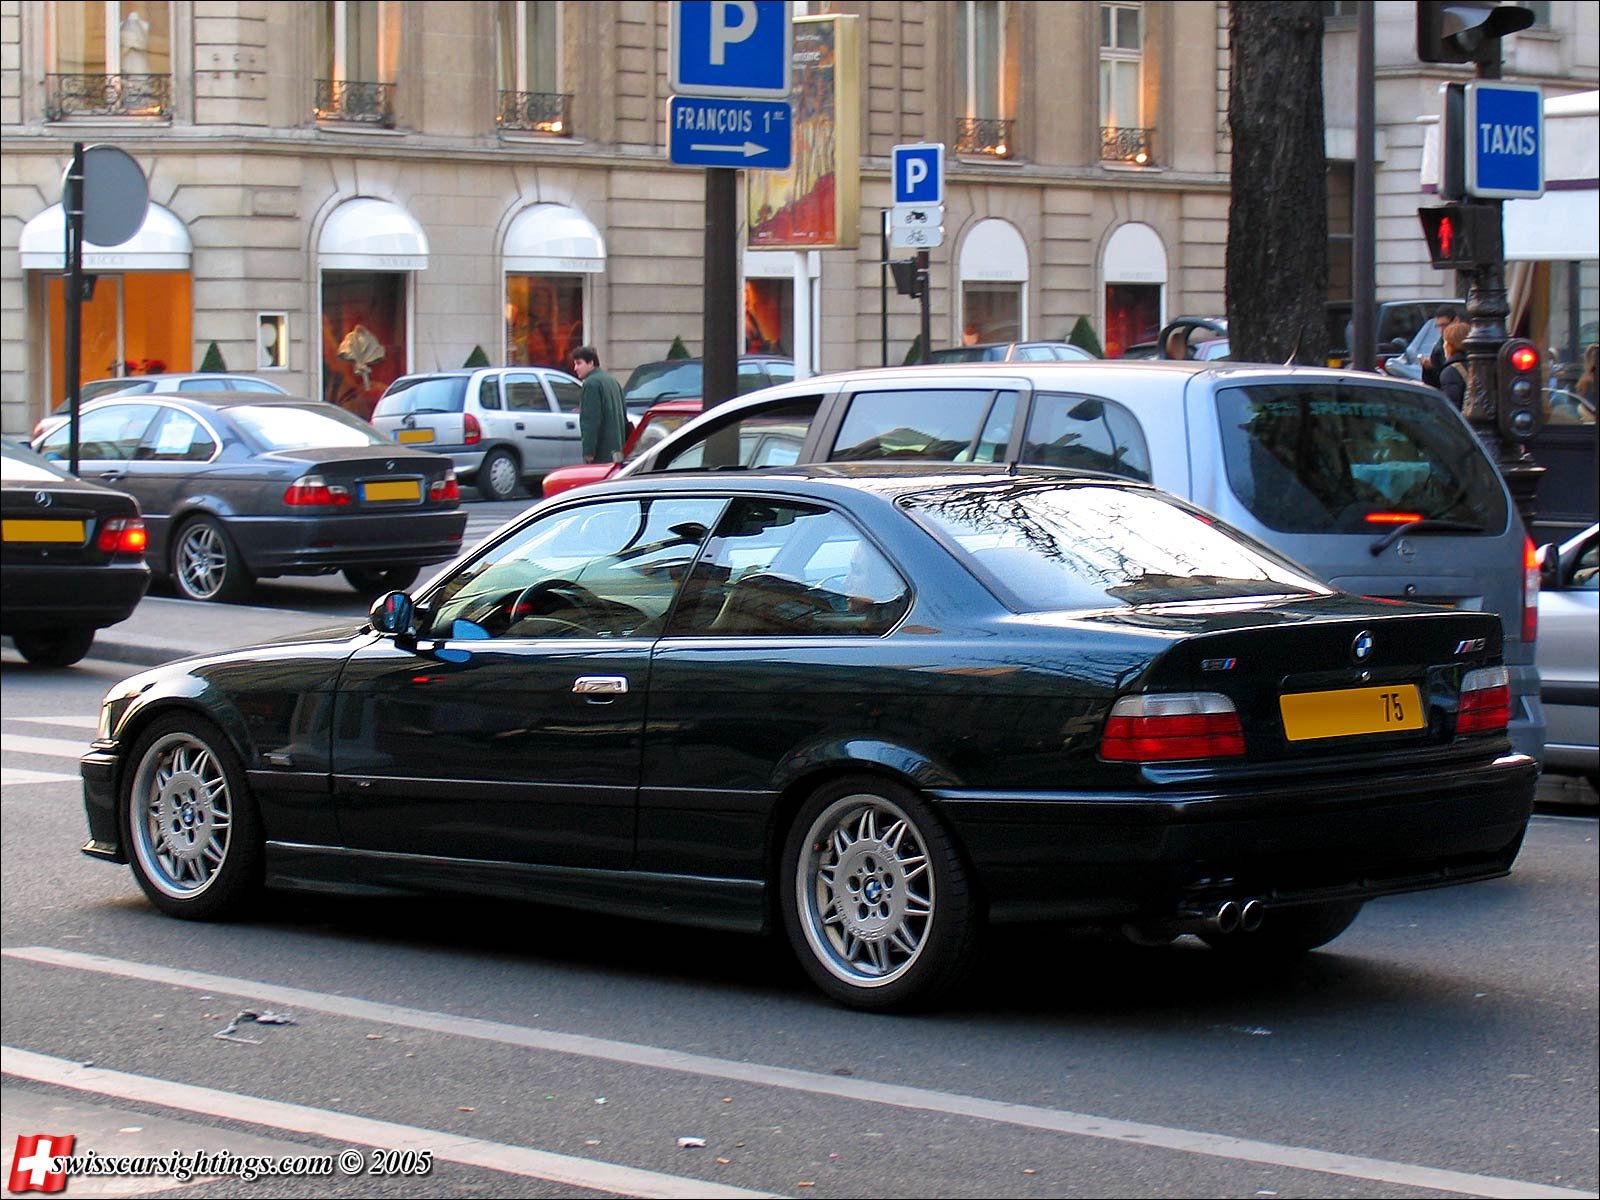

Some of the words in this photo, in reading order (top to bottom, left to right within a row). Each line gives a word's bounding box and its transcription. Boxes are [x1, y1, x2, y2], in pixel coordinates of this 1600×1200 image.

[708, 1, 758, 65] P
[676, 106, 753, 134] FRANÇOIS
[1480, 123, 1536, 156] TAXIS
[906, 158, 928, 194] P
[1380, 693, 1404, 722] 75
